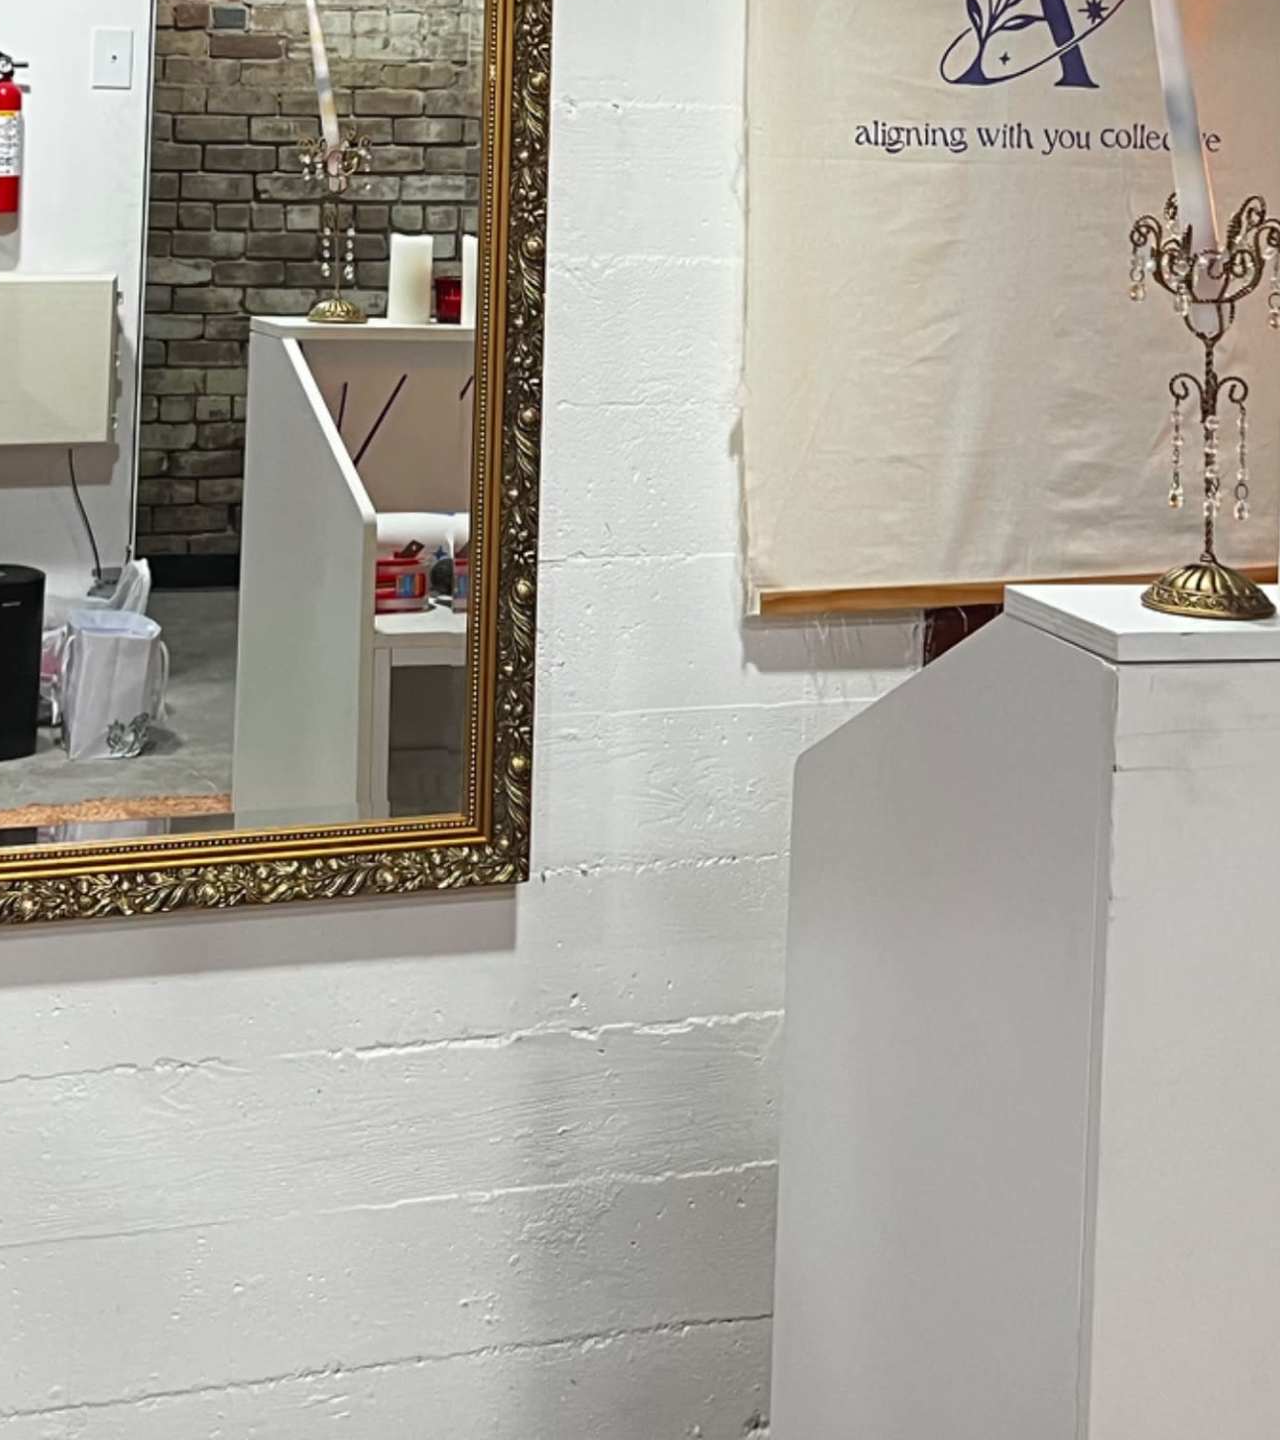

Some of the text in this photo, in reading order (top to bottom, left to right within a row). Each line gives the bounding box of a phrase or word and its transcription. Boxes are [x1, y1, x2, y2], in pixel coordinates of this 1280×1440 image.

[854, 120, 1221, 156] aligning with you collee
